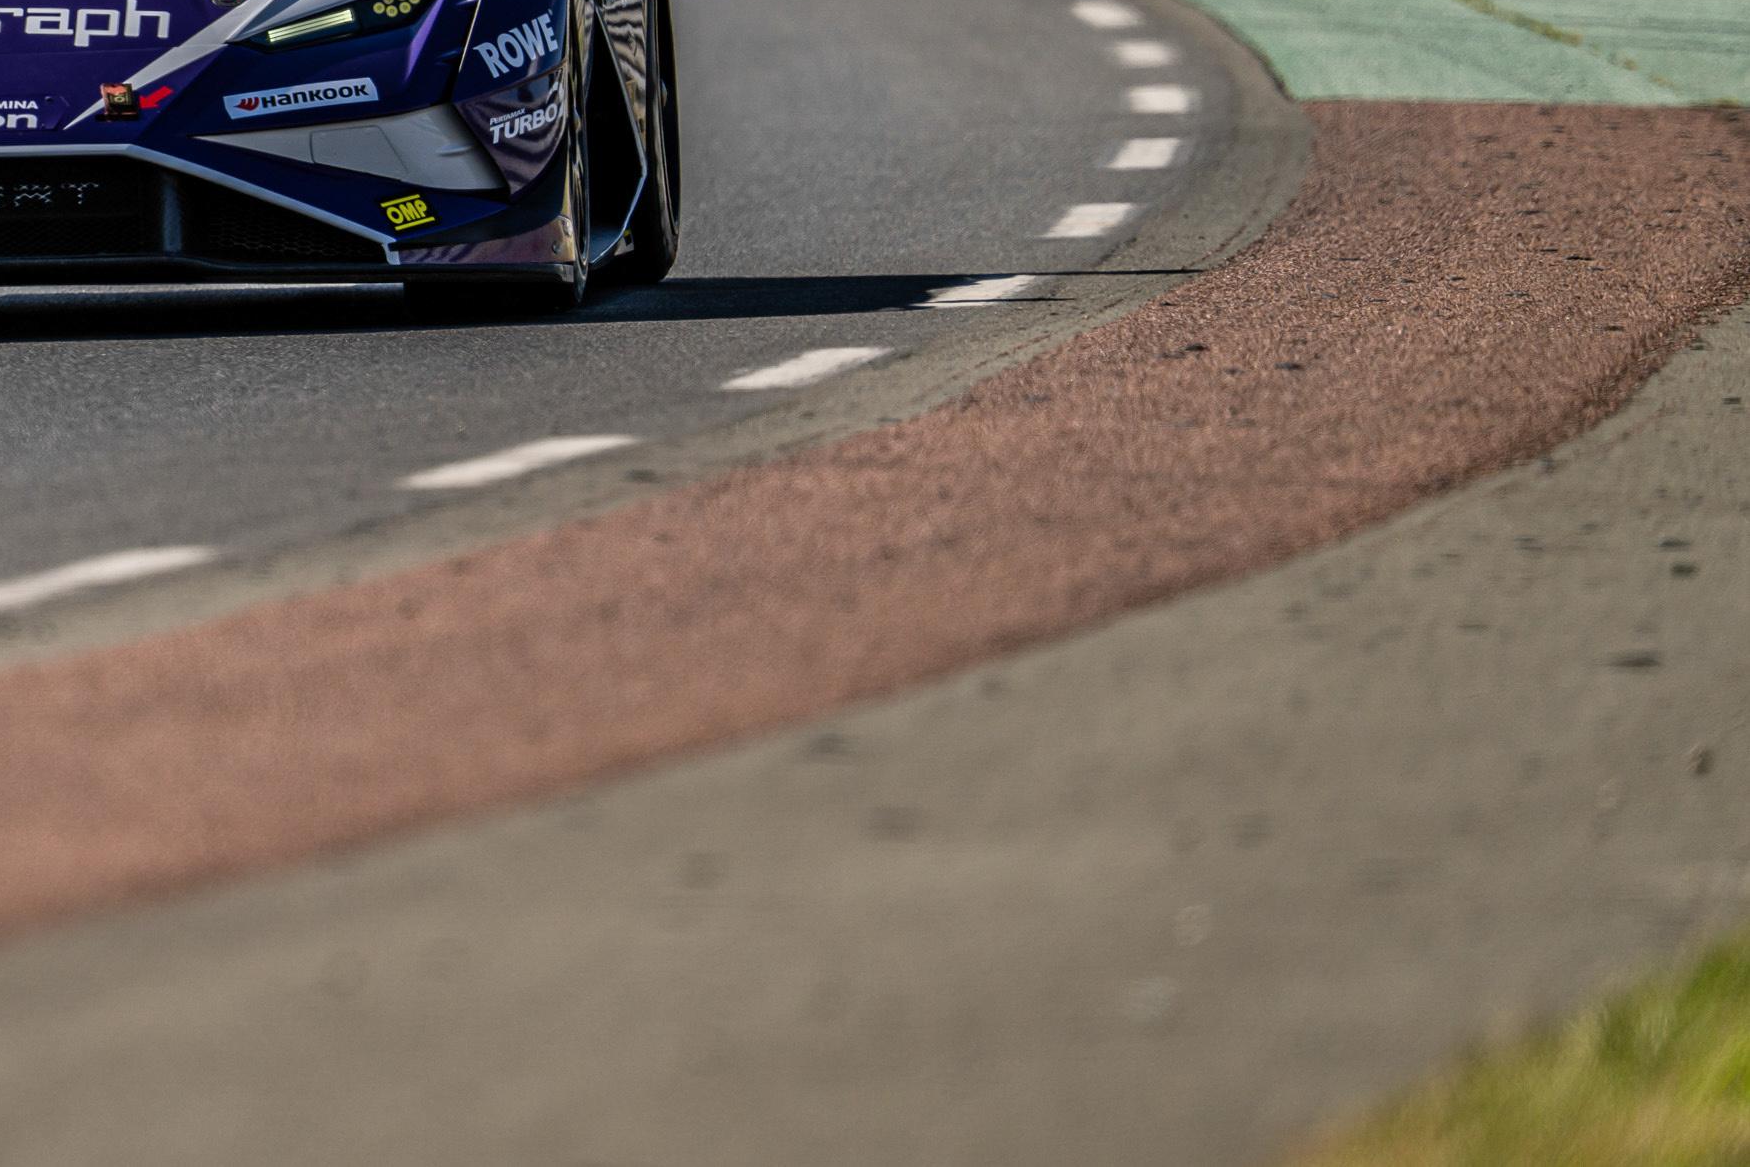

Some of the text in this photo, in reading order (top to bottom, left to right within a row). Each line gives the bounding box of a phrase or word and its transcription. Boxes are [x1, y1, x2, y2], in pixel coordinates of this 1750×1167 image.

[473, 13, 559, 78] ROWE
[489, 102, 558, 145] TURBO
[386, 199, 428, 225] OMP
